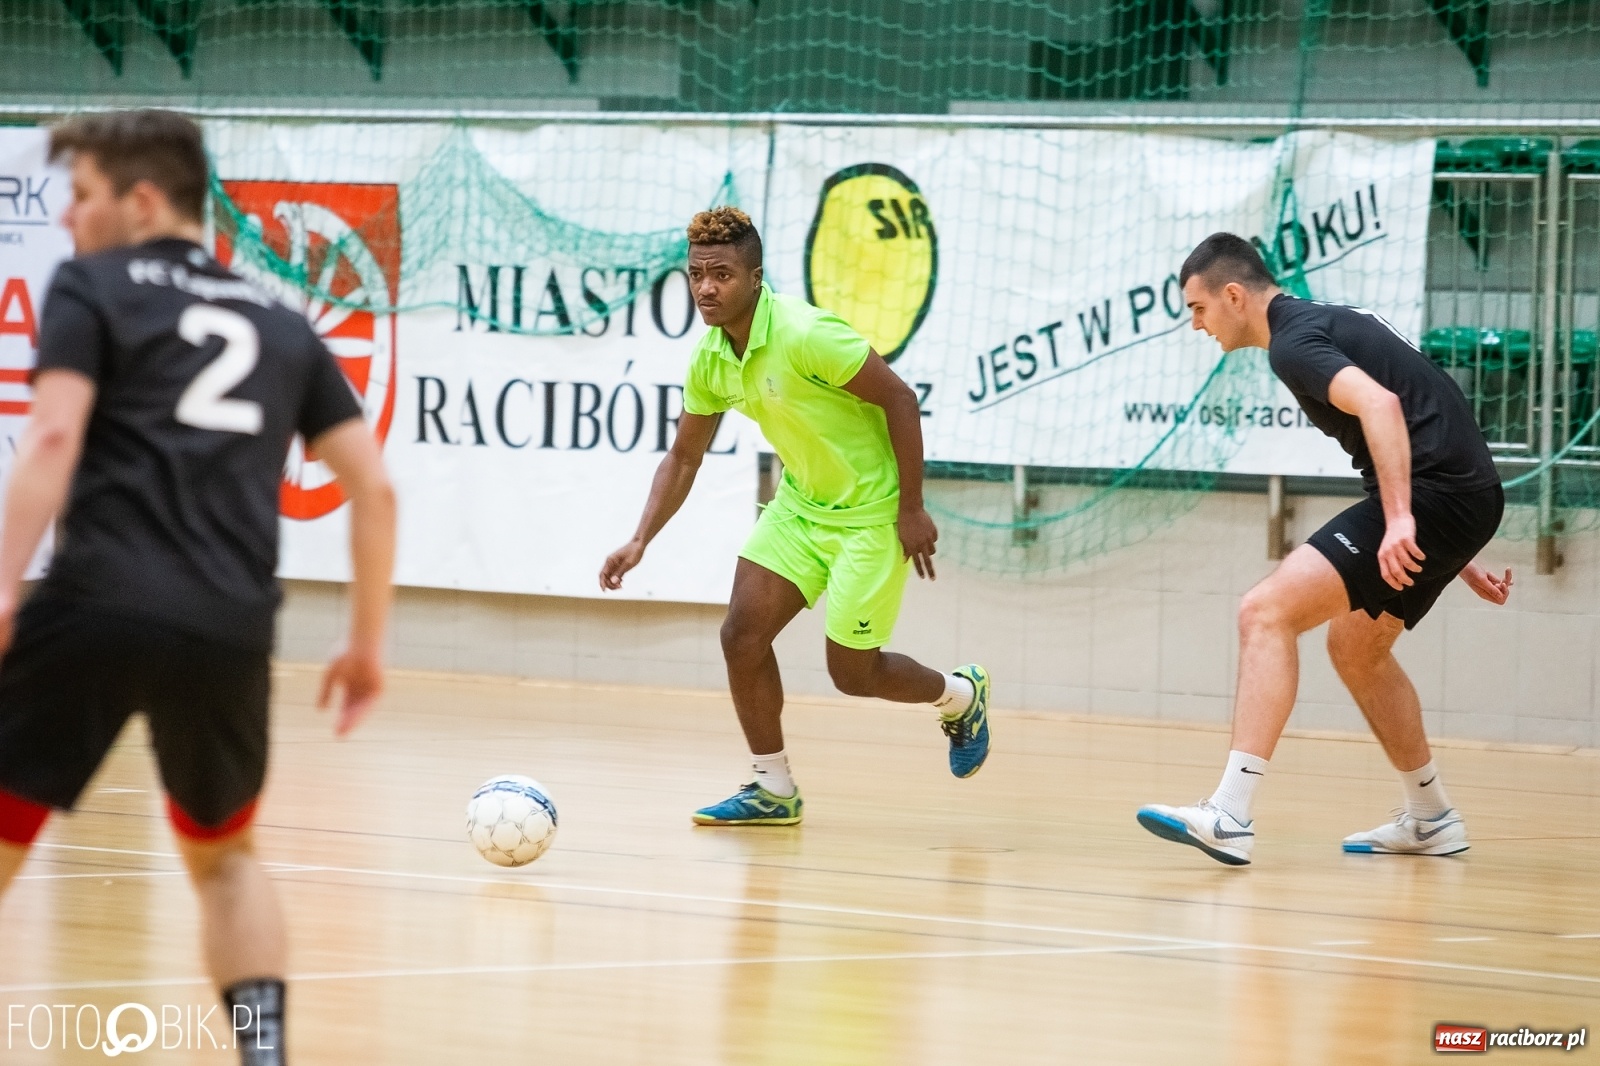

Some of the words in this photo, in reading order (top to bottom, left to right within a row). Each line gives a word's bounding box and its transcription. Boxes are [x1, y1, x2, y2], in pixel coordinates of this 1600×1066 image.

[453, 264, 696, 339] MIASTO
[968, 320, 1063, 402] JEST
[1077, 299, 1110, 353] W
[174, 303, 264, 436] 2
